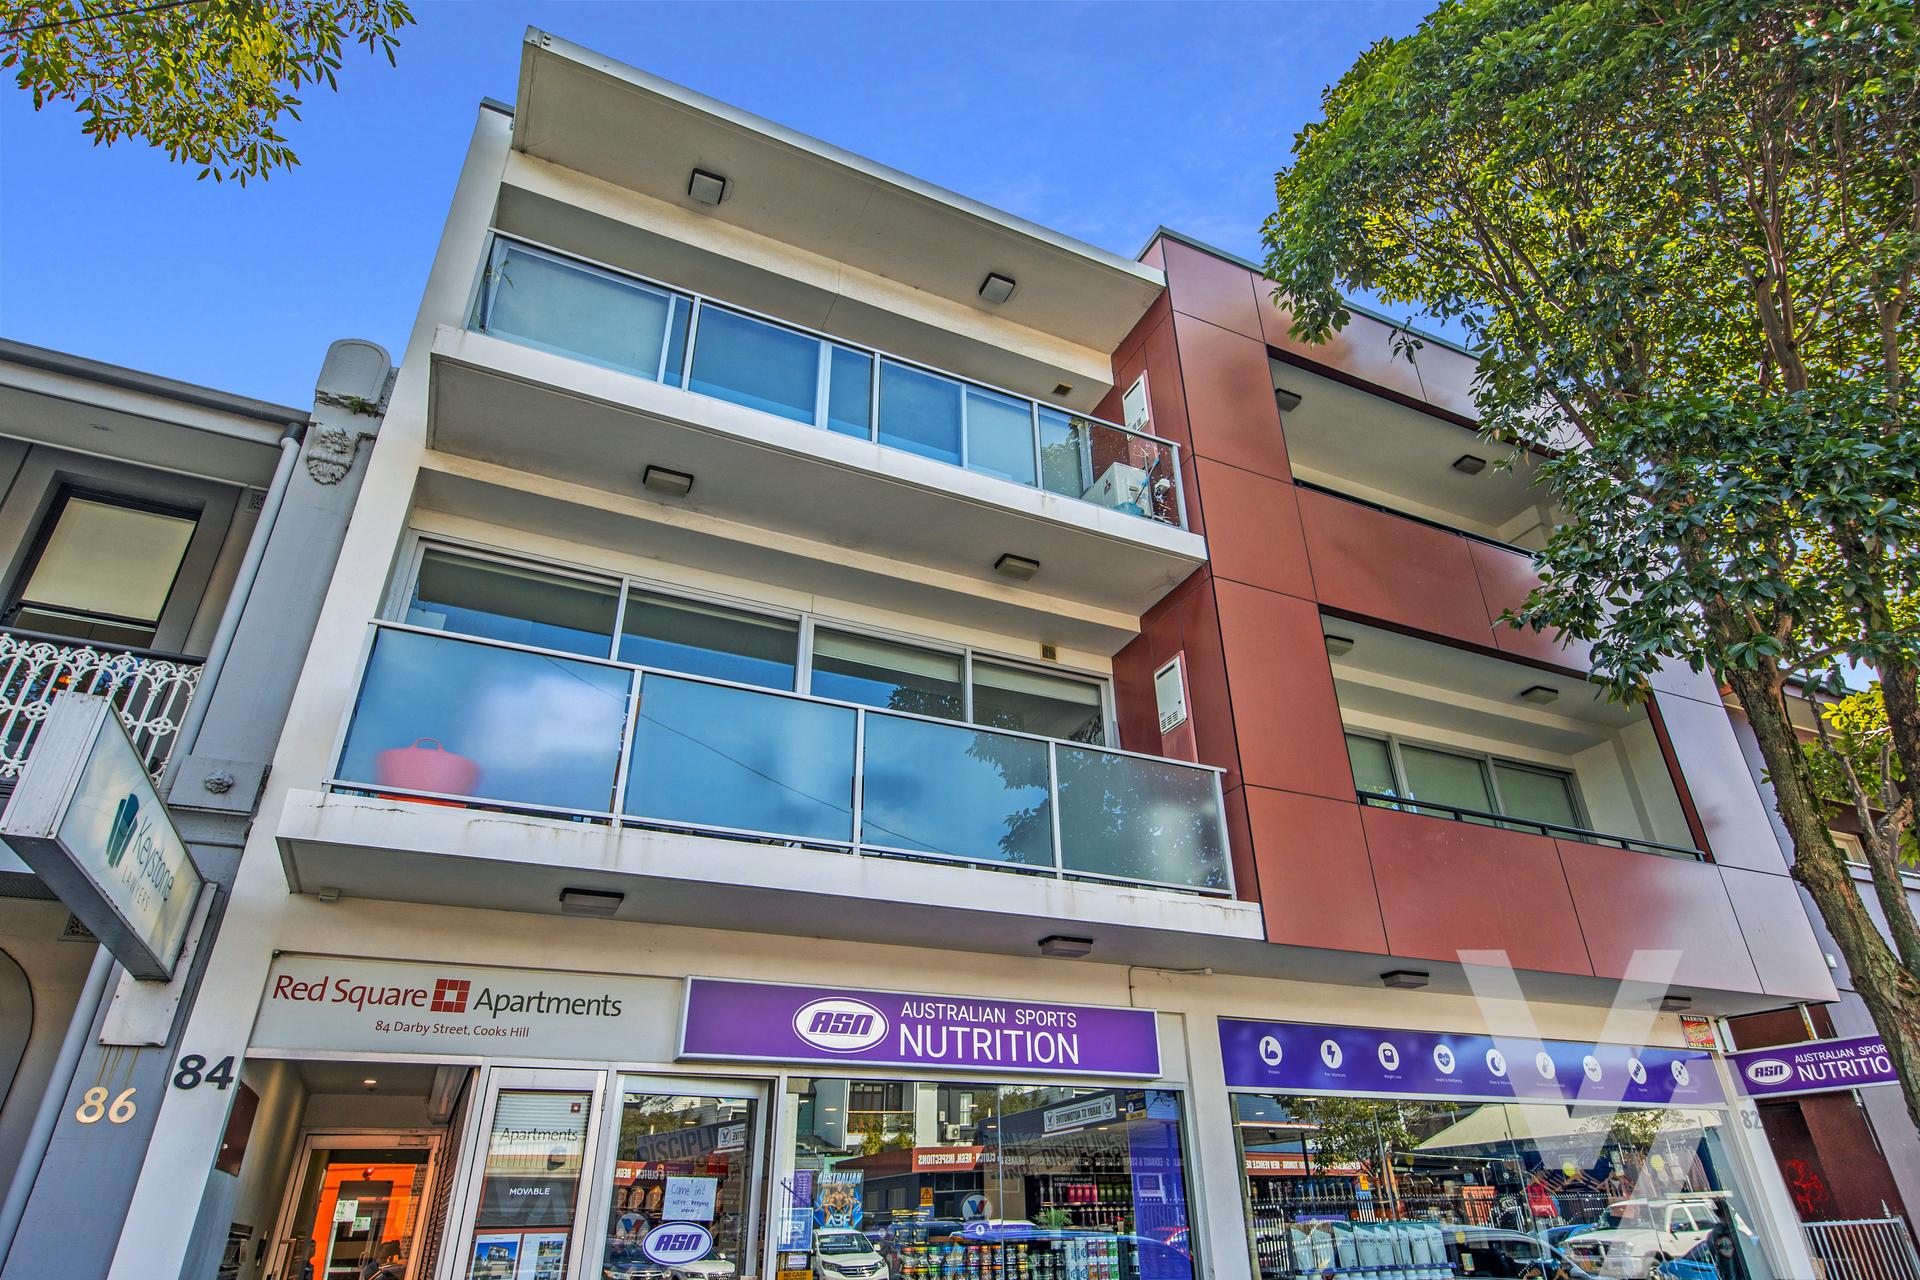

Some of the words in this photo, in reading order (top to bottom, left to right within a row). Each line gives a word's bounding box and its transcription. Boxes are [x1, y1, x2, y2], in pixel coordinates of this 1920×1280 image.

[133, 815, 175, 902] Keystone
[121, 865, 151, 912] LAWYERS
[273, 974, 329, 1002] Red
[331, 979, 428, 1012] Square
[473, 987, 622, 1018] Apartments
[807, 1011, 876, 1037] ASN
[900, 1001, 1006, 1024] AUSTRALIAN
[1015, 1009, 1077, 1029] SPORTS
[375, 1020, 391, 1034] 84
[394, 1021, 430, 1035] Darby
[433, 1022, 471, 1036] Street,
[473, 1024, 507, 1038] Cooks
[510, 1025, 529, 1038] Hill
[899, 1023, 1080, 1065] NUTRITION
[1795, 1048, 1855, 1064] AUSTRALIAN
[1858, 1044, 1888, 1056] SPOR
[173, 1054, 235, 1090] 84
[1754, 1064, 1784, 1078] ASN
[1797, 1055, 1892, 1083] NUTRITIO
[75, 1086, 137, 1124] 86
[1741, 1109, 1762, 1130] 82
[500, 1127, 578, 1145] Apartments
[817, 1171, 863, 1185] AUSTRALIAN
[509, 1187, 550, 1196] MOVABLE
[653, 1233, 703, 1251] ASN
